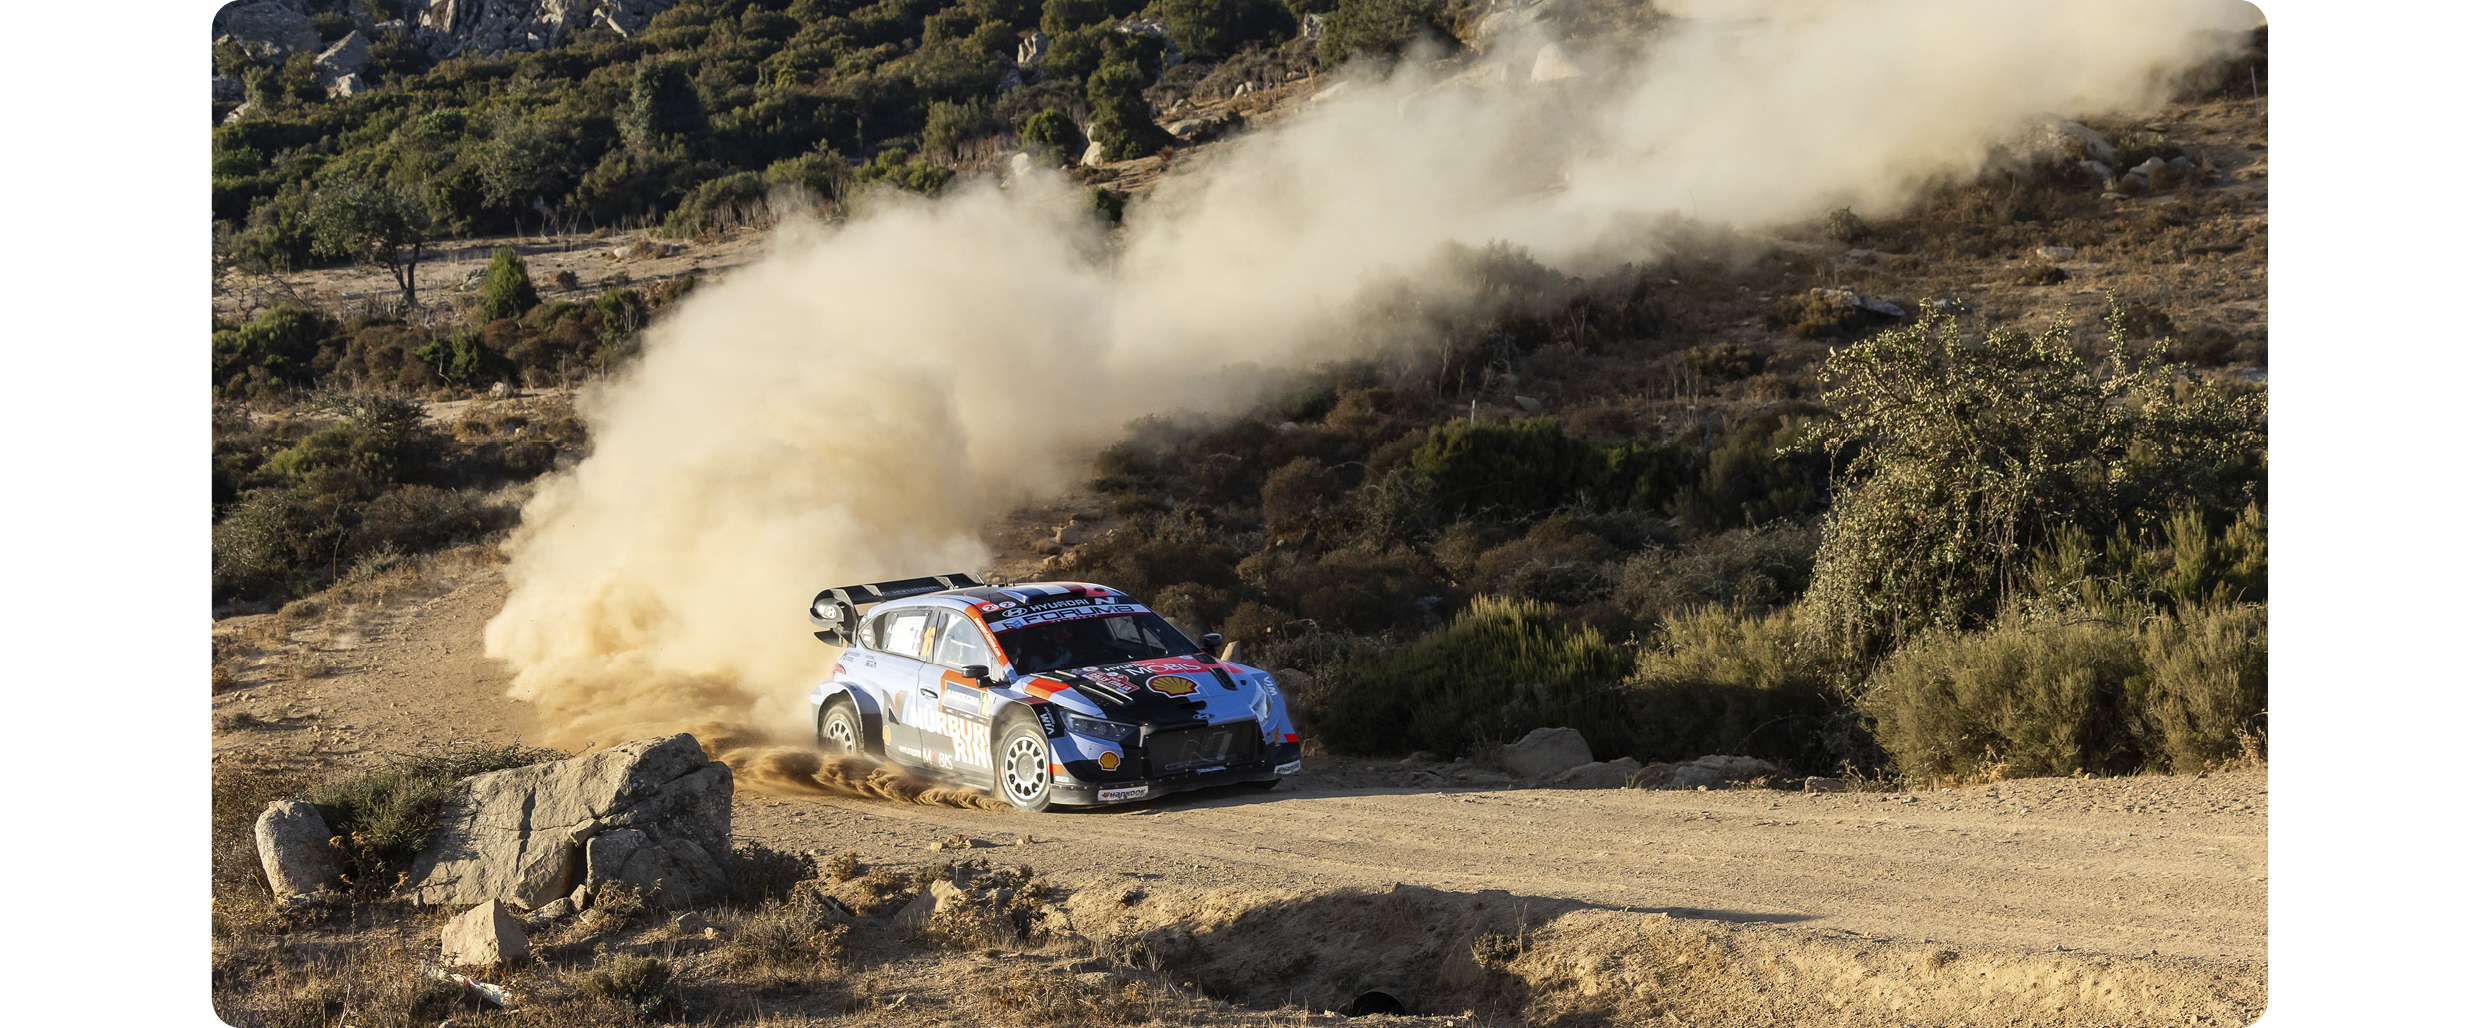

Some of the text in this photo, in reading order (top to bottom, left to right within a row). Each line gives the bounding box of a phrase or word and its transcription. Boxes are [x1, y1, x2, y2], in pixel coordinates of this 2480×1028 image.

[1022, 605, 1135, 624] FORUM8
[1029, 598, 1090, 612] HYUNDAI
[921, 626, 936, 657] 16
[1124, 663, 1202, 676] MOBIS
[922, 748, 953, 770] MOBIS
